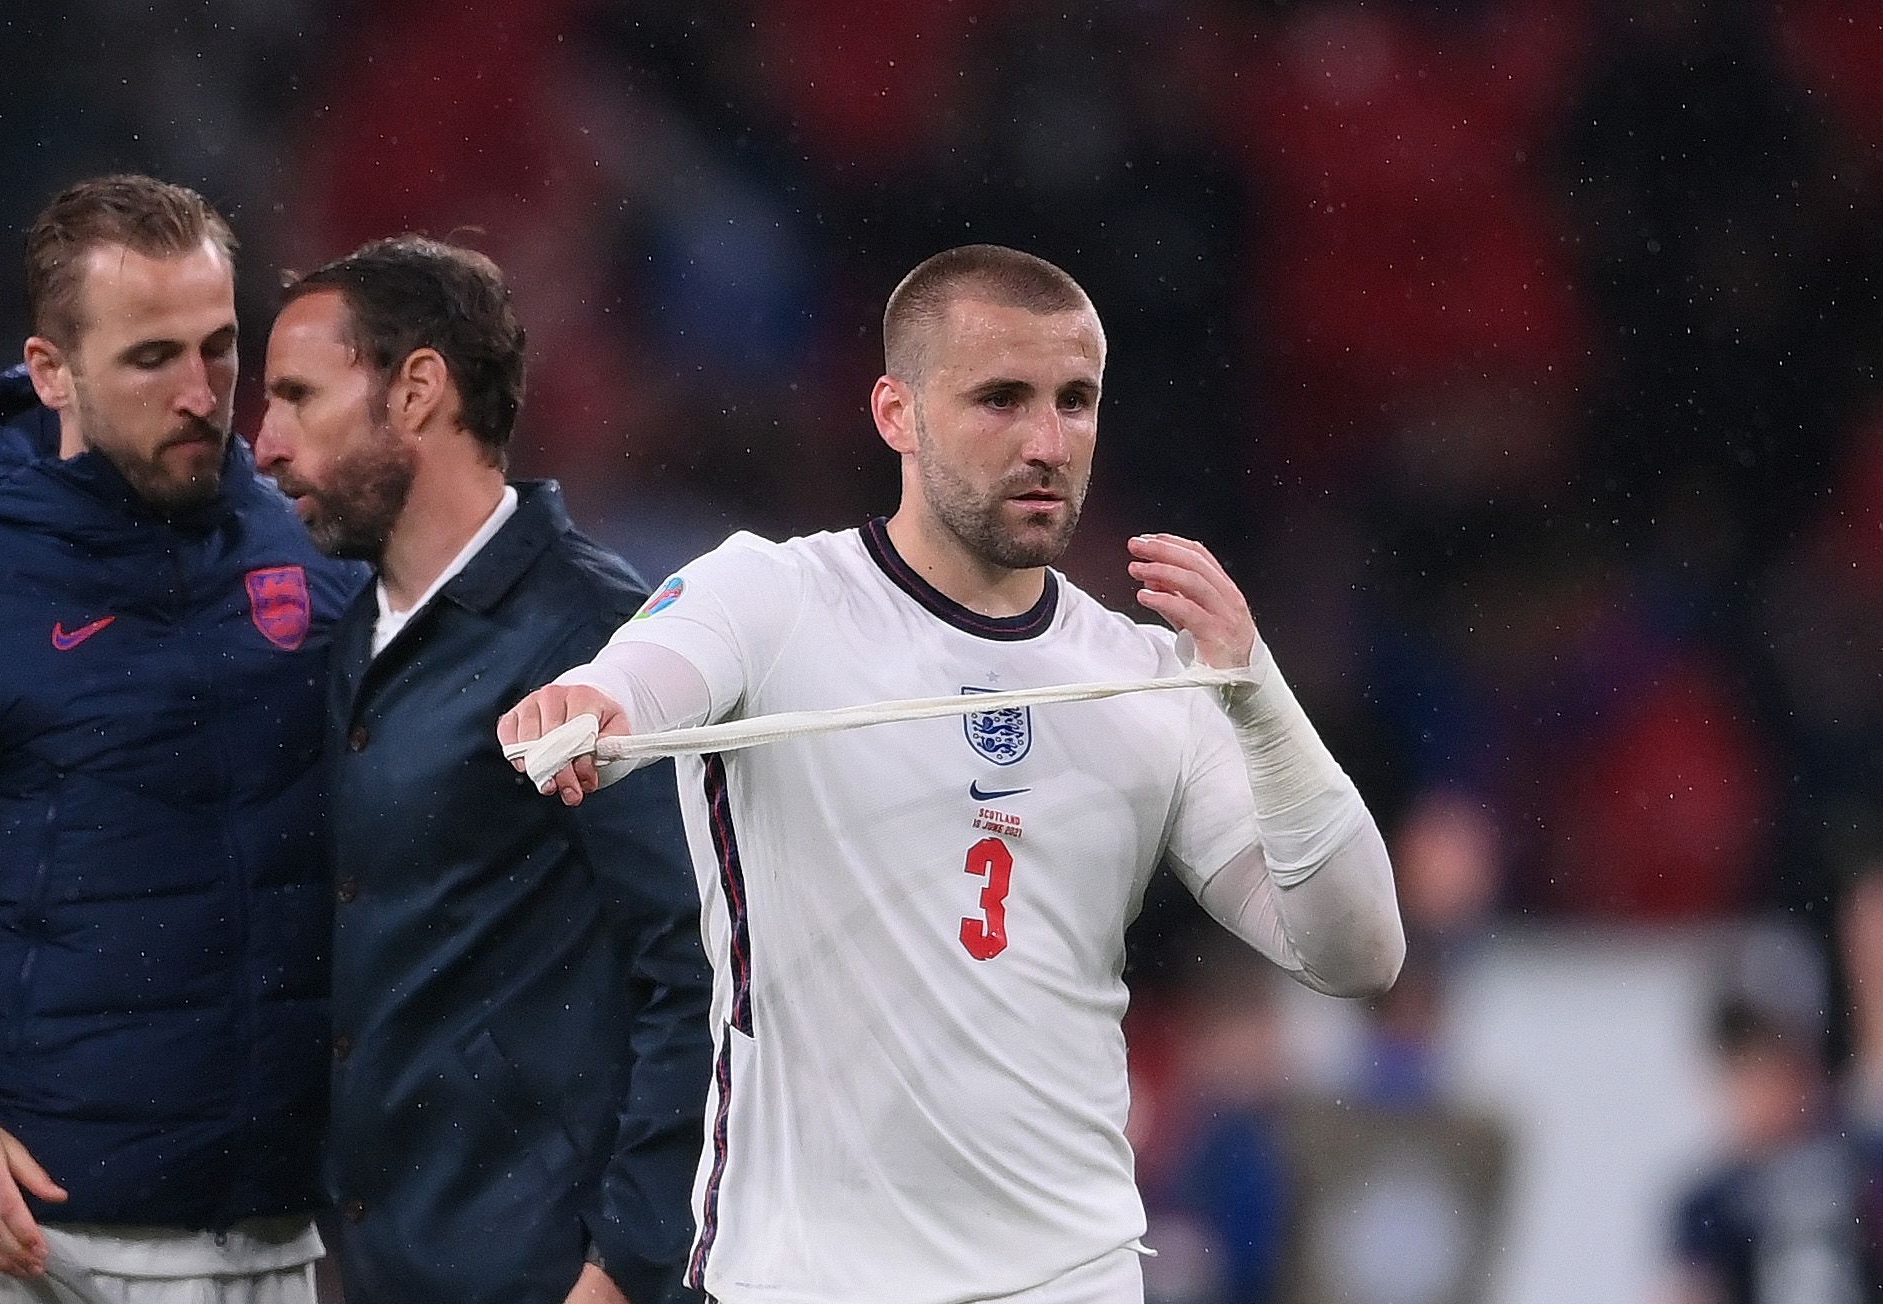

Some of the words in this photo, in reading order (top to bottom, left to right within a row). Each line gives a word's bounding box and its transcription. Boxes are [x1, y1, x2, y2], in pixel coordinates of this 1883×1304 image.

[978, 807, 1021, 826] SCOTLAND
[982, 821, 1005, 834] JUNE
[1004, 825, 1023, 839] 2021
[959, 837, 1013, 960] 3
